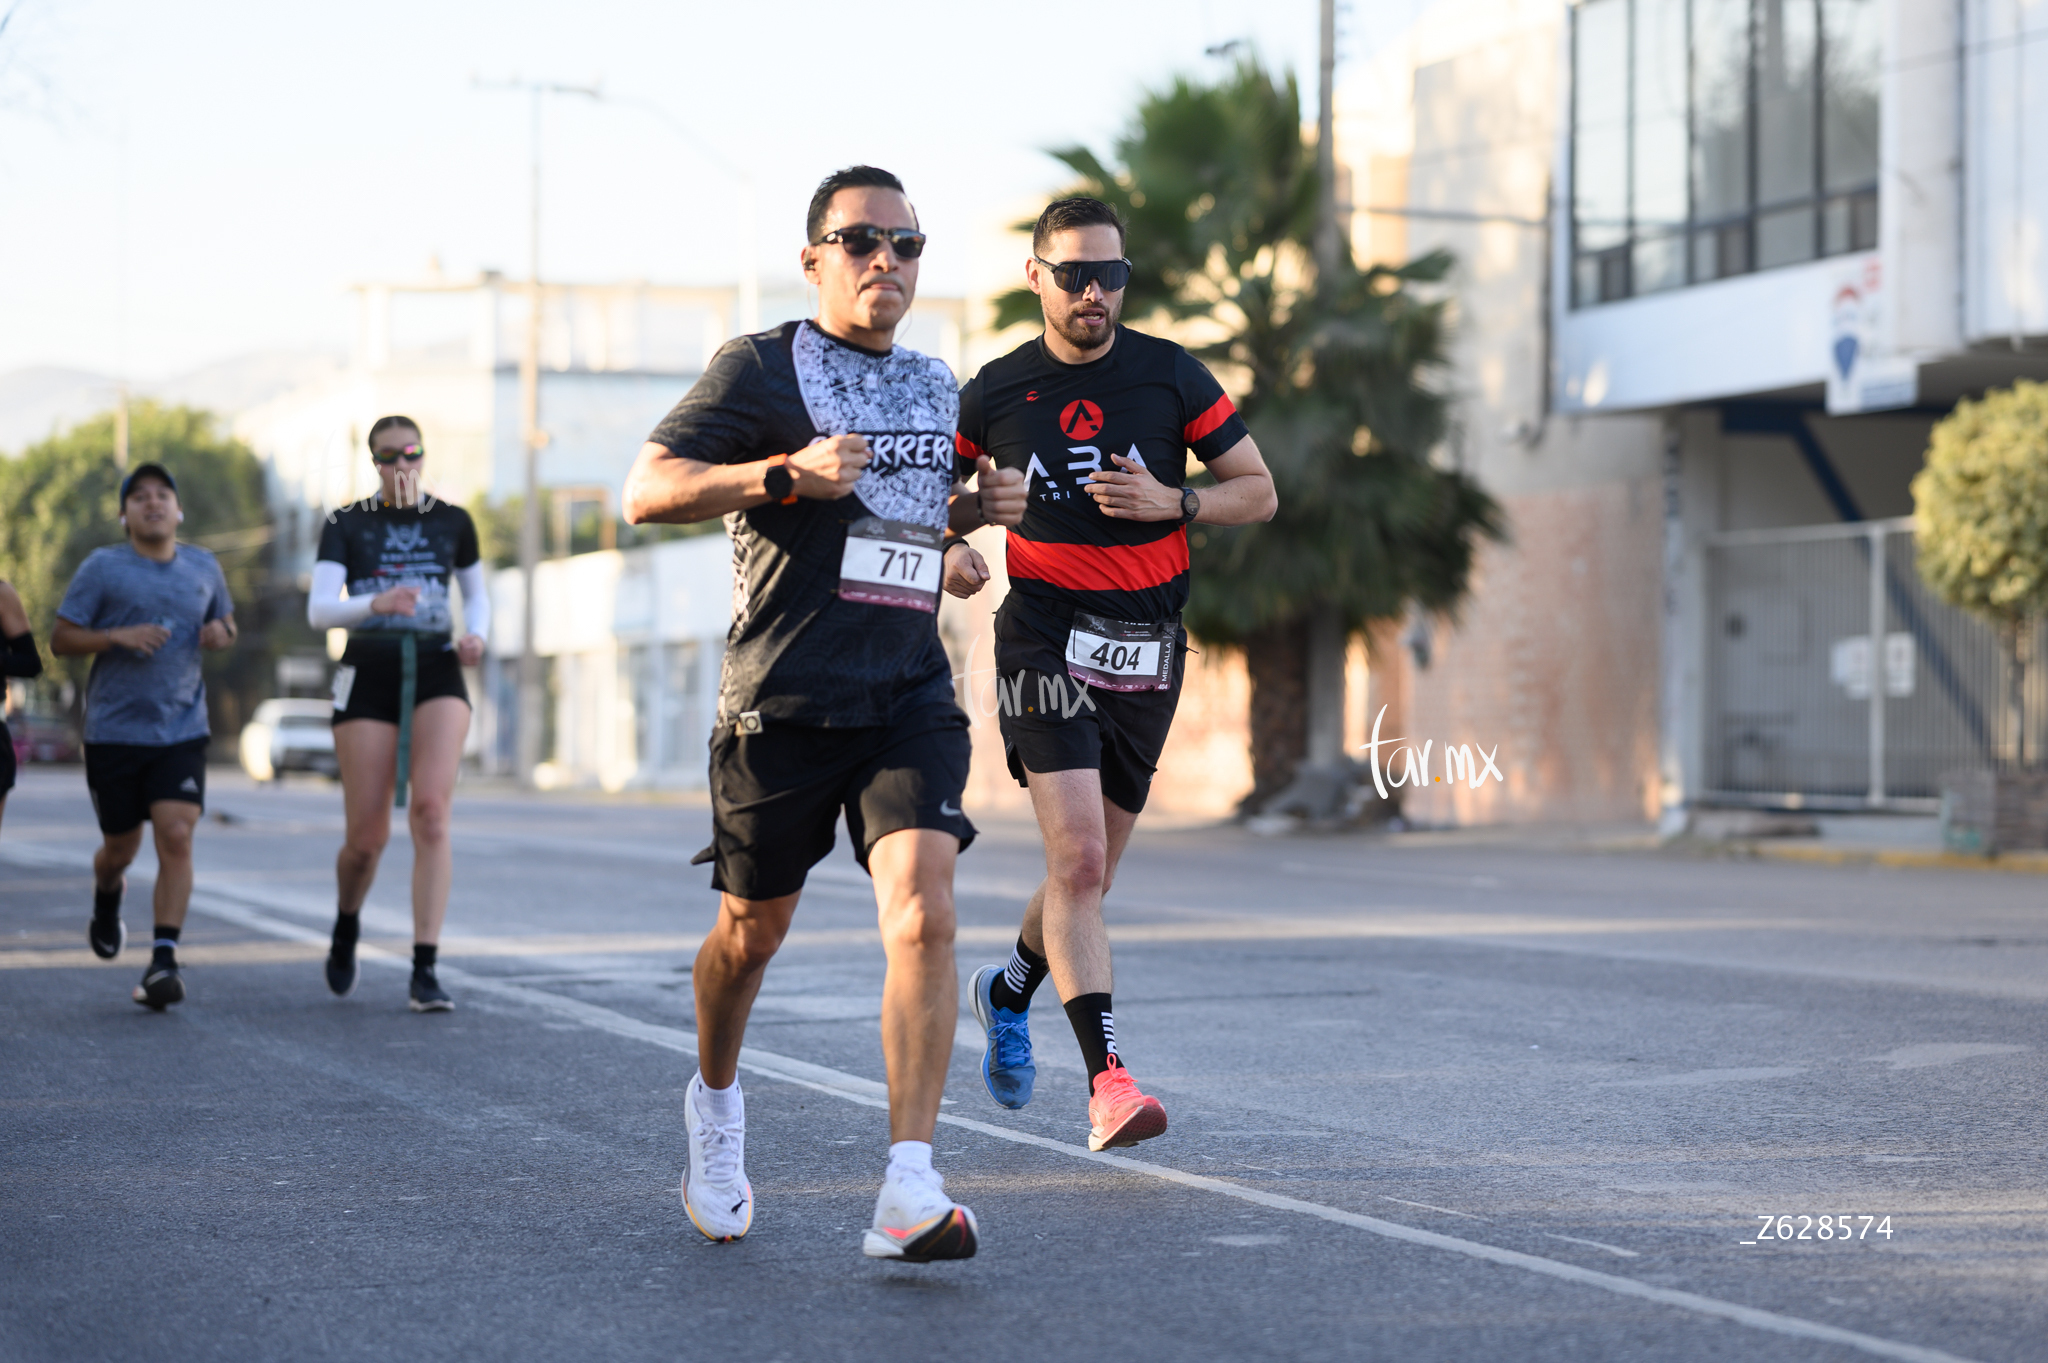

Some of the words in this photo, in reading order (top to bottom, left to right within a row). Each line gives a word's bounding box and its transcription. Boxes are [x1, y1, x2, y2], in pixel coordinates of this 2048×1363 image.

[1039, 490, 1070, 502] TRI
[879, 547, 924, 582] 717
[1090, 642, 1142, 671] 404
[1162, 642, 1172, 682] MEDALLA
